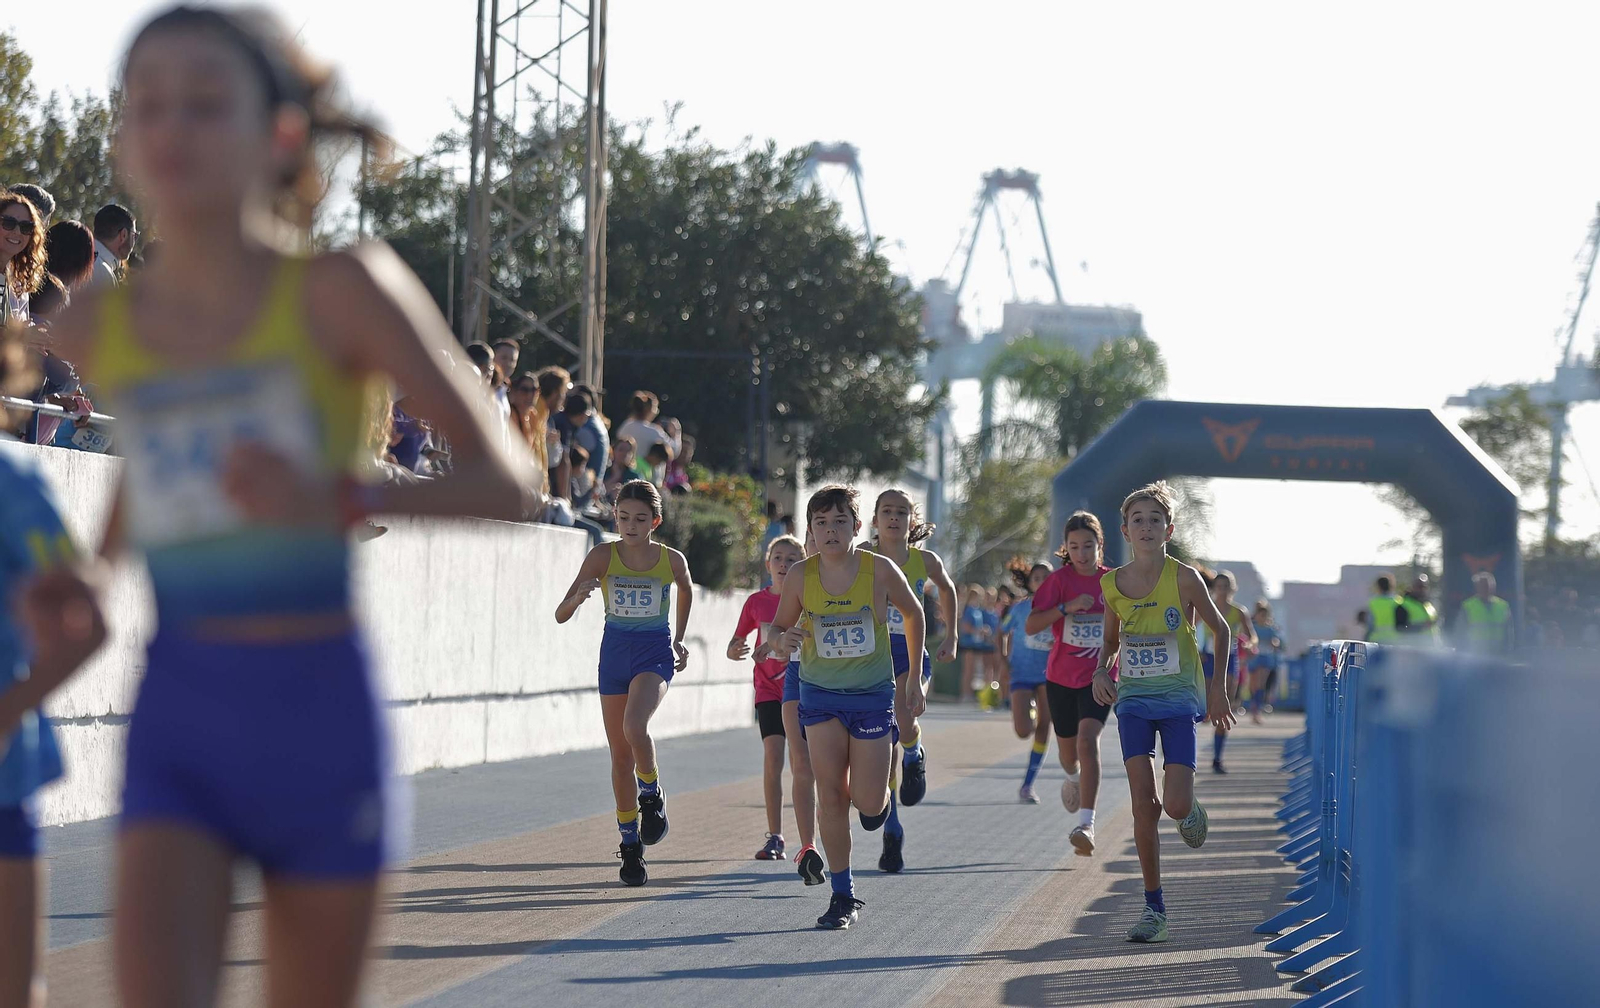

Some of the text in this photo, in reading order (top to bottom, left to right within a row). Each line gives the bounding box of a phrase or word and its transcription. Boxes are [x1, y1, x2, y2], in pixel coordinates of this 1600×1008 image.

[614, 589, 652, 606] 315
[823, 627, 866, 646] 413
[1071, 625, 1102, 638] 336
[1126, 648, 1168, 666] 385
